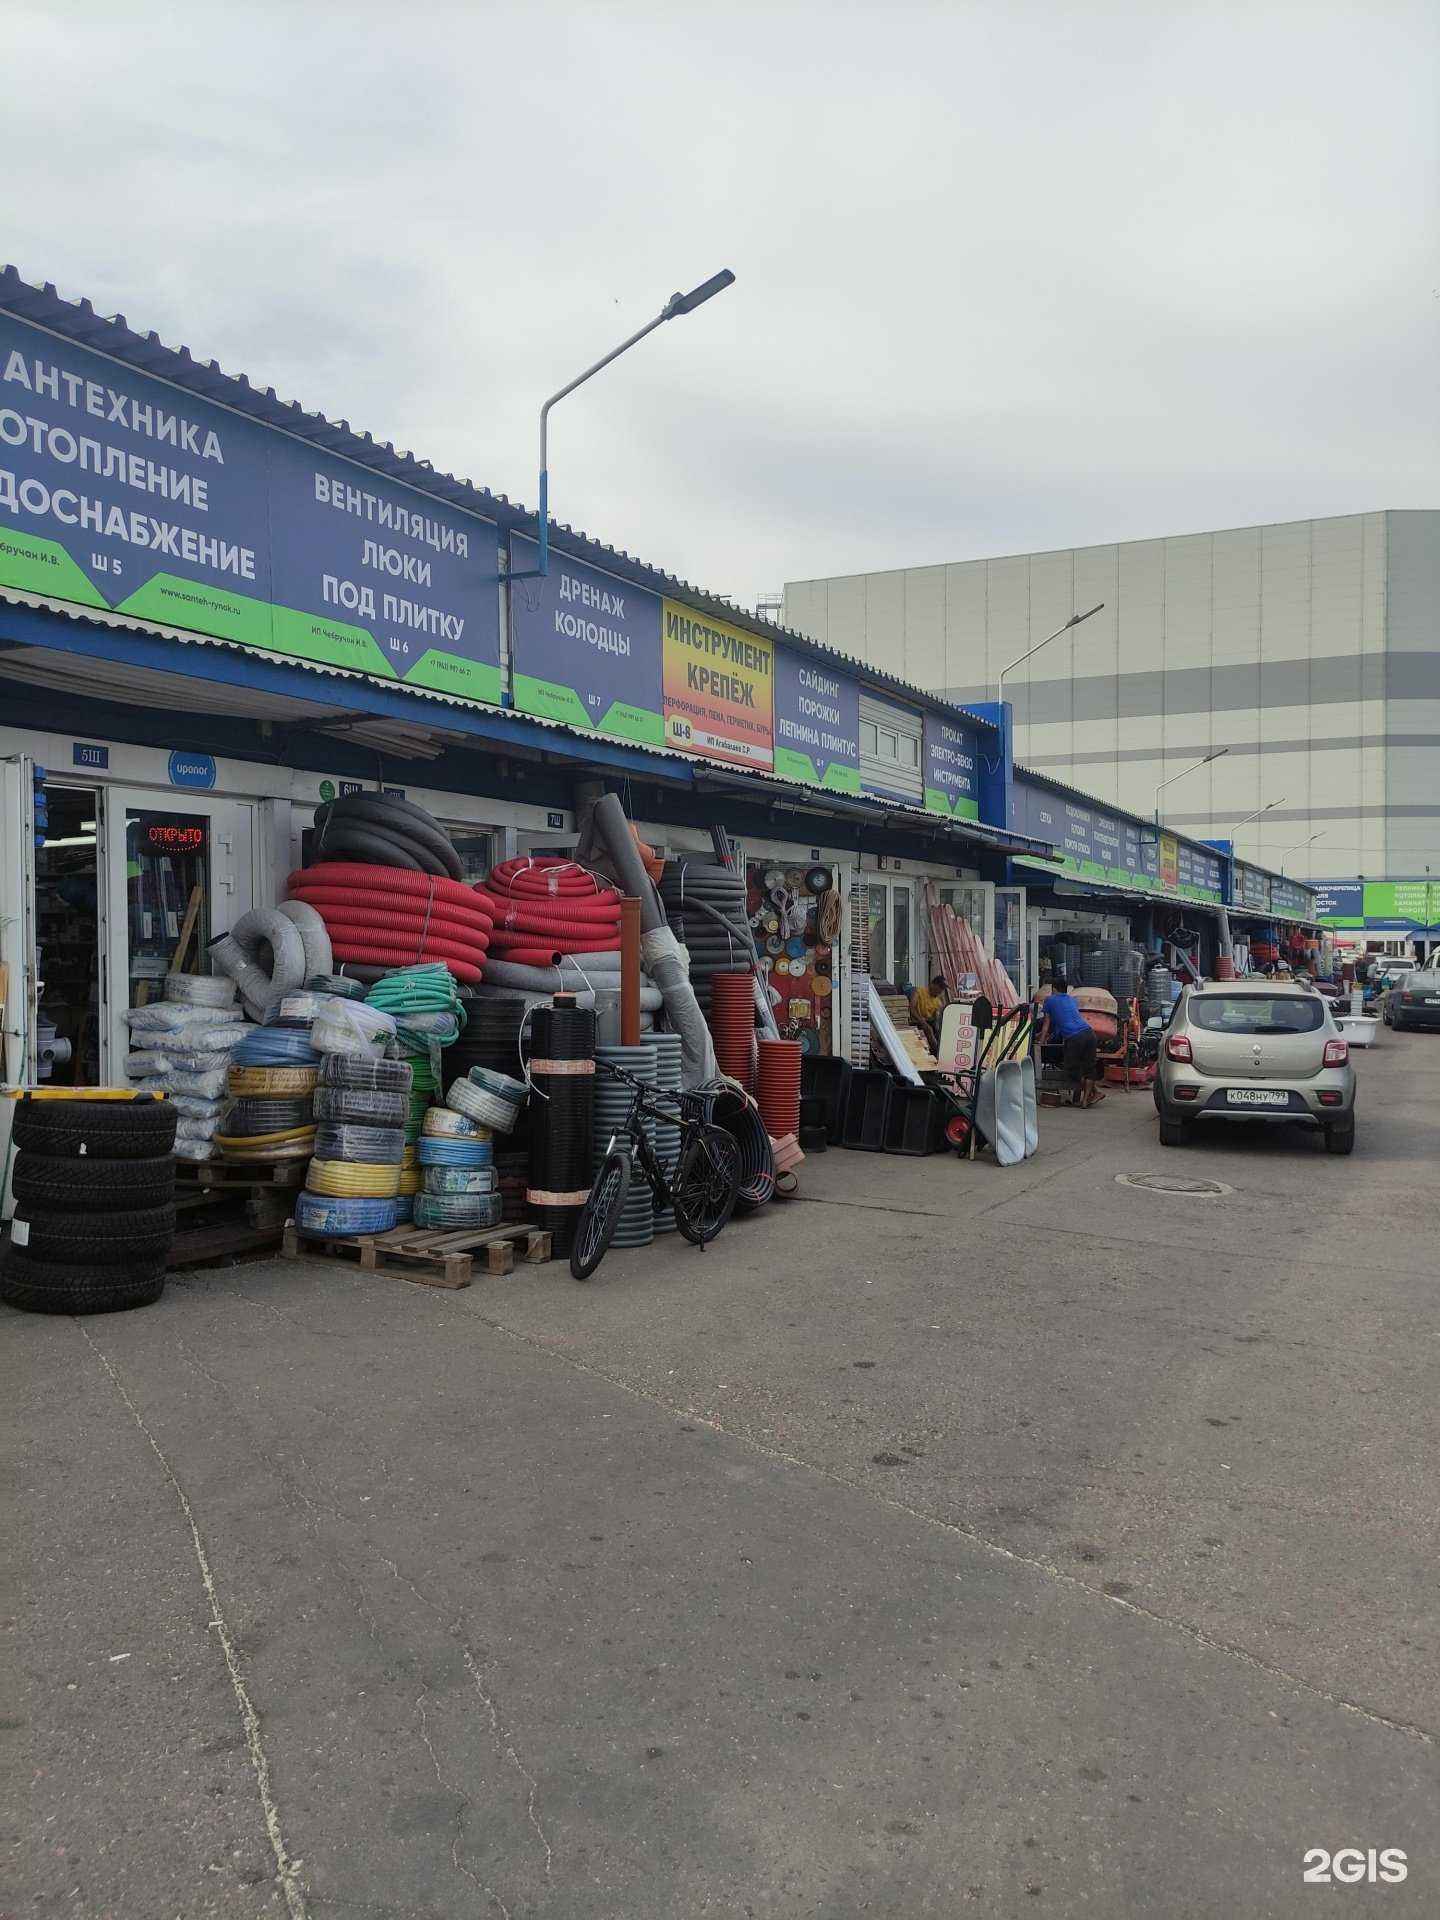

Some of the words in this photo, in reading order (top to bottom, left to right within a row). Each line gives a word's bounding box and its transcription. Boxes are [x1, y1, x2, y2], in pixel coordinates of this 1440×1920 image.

[3, 350, 225, 465] АНТЕХНИКА
[0, 408, 209, 512] ОТОПЛЕНИЕ
[0, 469, 256, 580] ДОСНАБЖЕНИЕ
[314, 472, 469, 559] ВЕНТИЛЯЦИЯ
[91, 552, 108, 572] Ш
[112, 558, 123, 576] 5
[361, 539, 432, 587] ЛЮКИ
[322, 574, 376, 621] ПОД
[382, 593, 465, 641] ПЛИТКУ
[559, 573, 625, 619] ДРЕНАЖ
[389, 636, 401, 652] Ш
[402, 640, 409, 654] 6
[555, 609, 631, 656] КОЛОДЦЫ
[666, 611, 770, 675] ИНСТРУМЕНТ
[687, 662, 756, 709] КРЕПЁЖ
[798, 667, 840, 699] САЙДИНГ
[672, 721, 692, 740] Ш-8
[798, 696, 840, 726] ПОРОЖКИ
[779, 718, 819, 747] ЛЕПНИНА
[821, 732, 857, 758] ПЛИНТУС
[941, 725, 964, 746] ПРОКАТ
[176, 762, 208, 777] uponor
[933, 767, 972, 792] ИНСТРУМЕНТА
[149, 826, 202, 843] ОТКРЫТО
